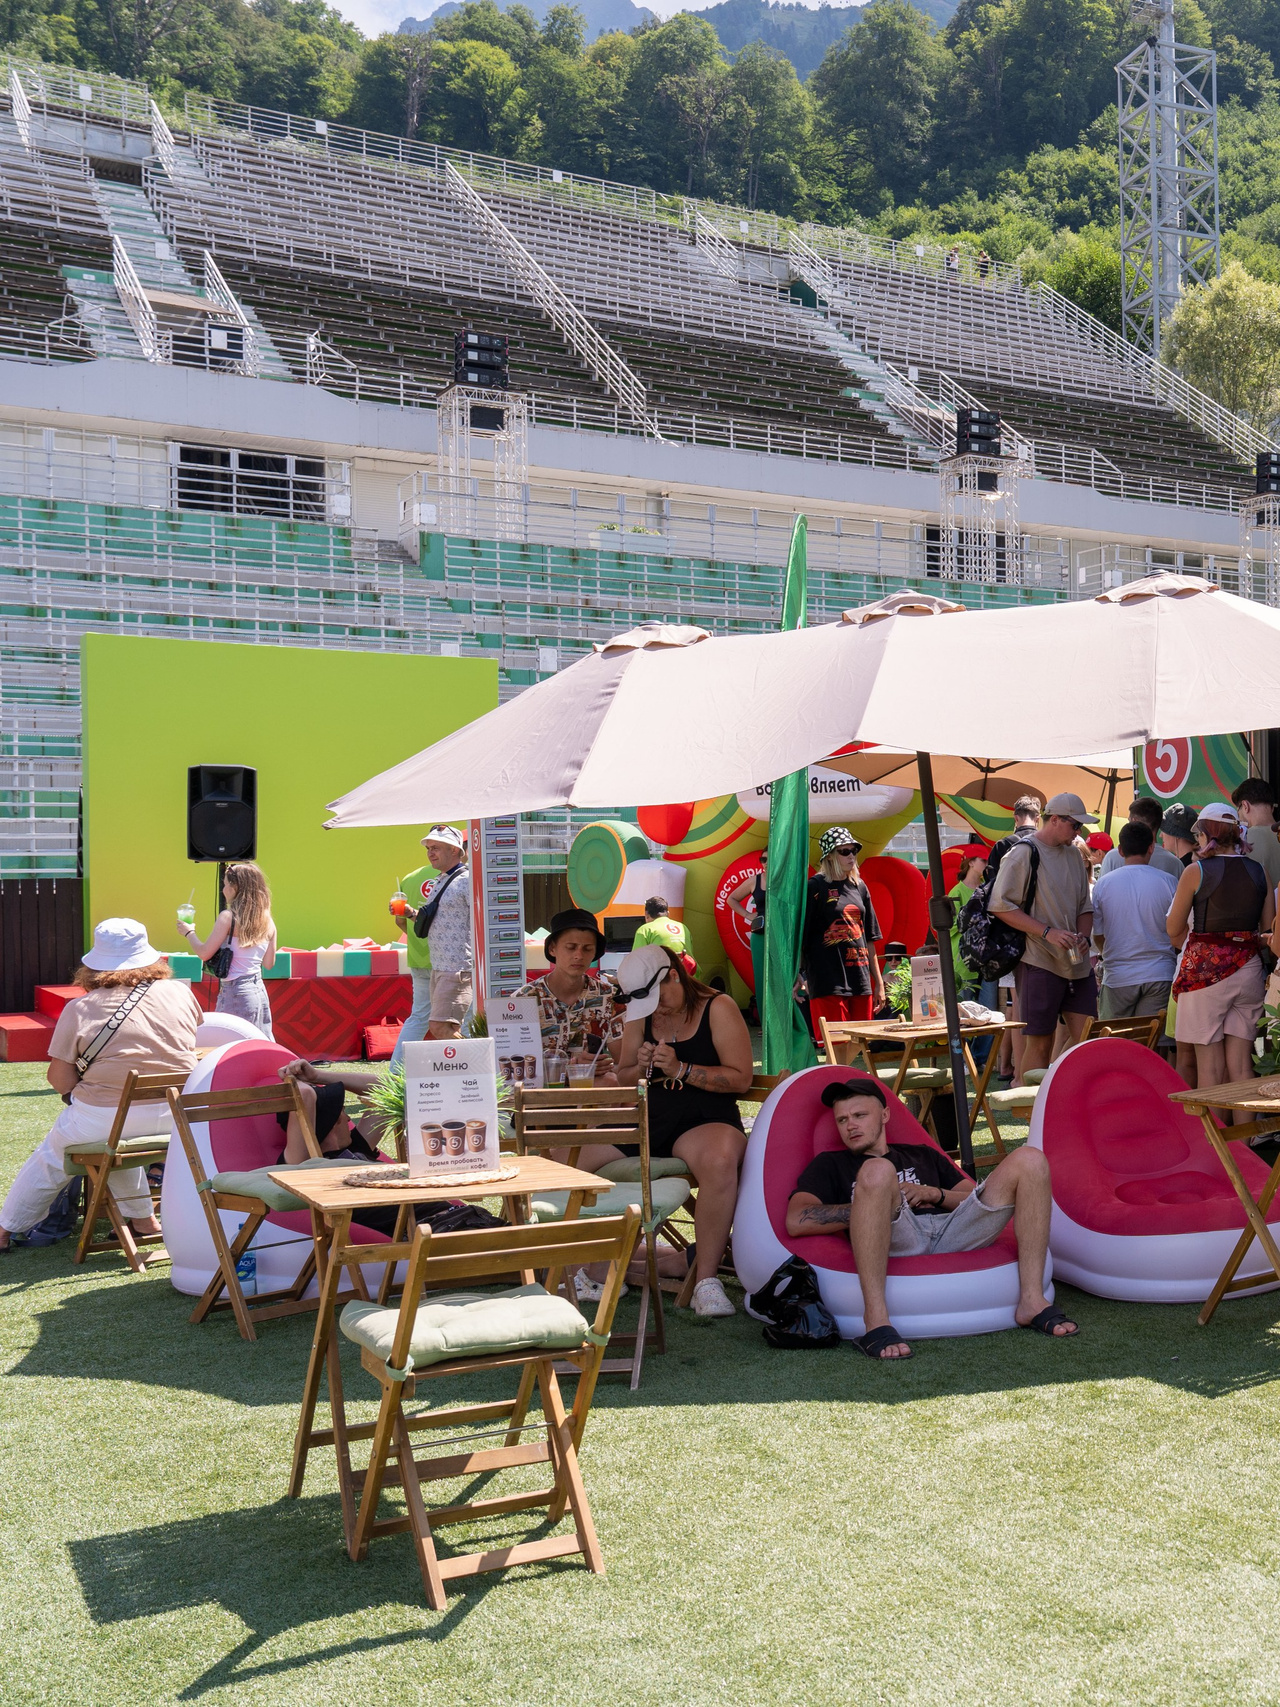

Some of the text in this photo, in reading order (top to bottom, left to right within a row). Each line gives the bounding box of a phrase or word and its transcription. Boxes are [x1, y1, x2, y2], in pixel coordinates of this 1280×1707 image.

[433, 1061, 469, 1072] Меню
[428, 1157, 484, 1168] Время пробовать
